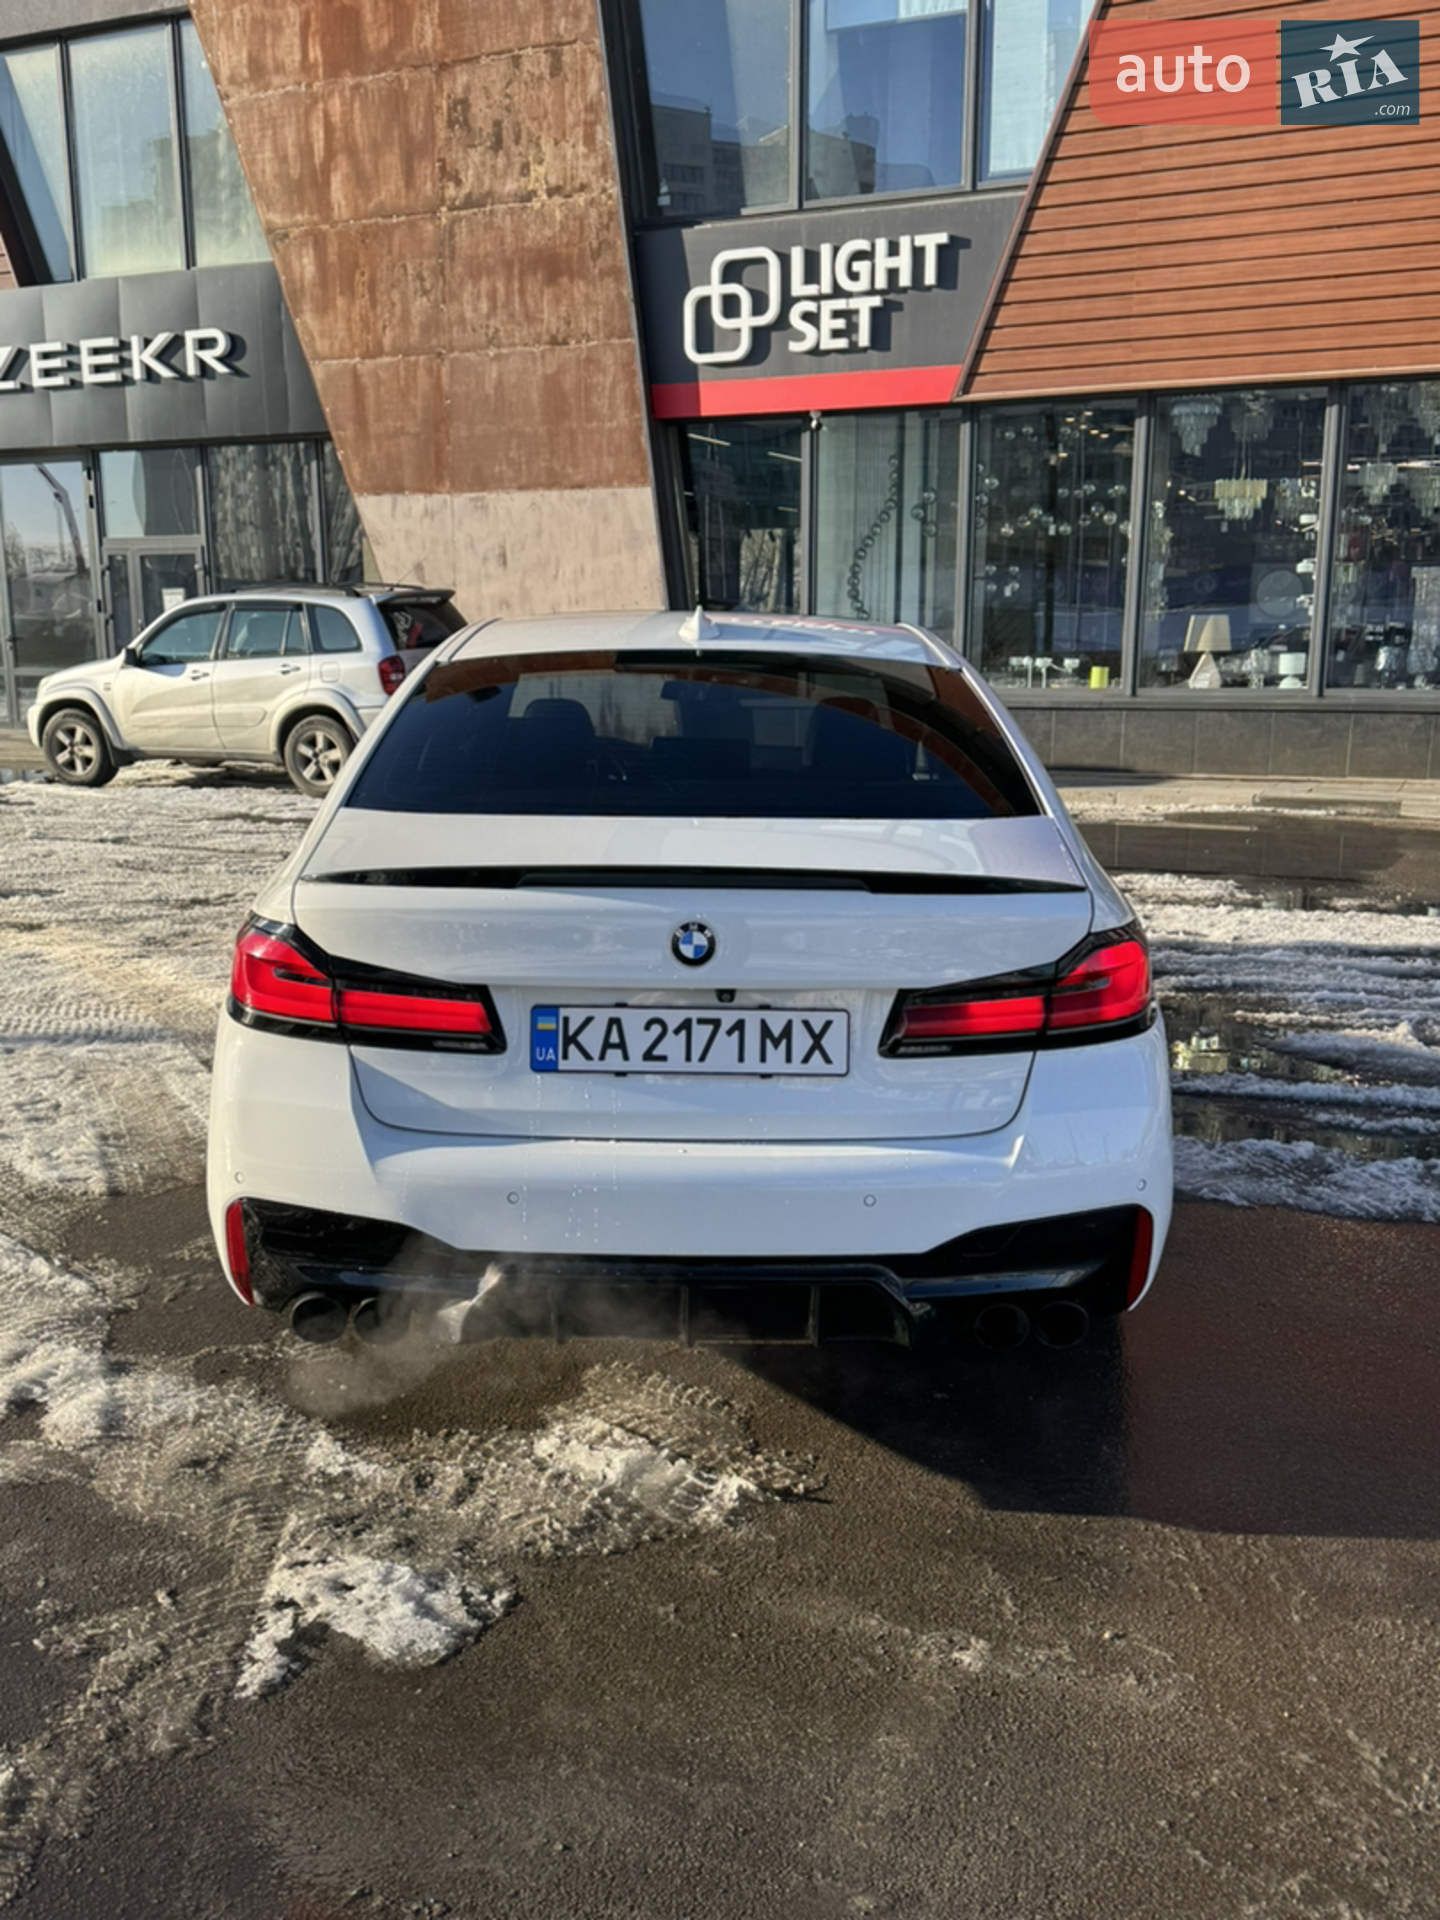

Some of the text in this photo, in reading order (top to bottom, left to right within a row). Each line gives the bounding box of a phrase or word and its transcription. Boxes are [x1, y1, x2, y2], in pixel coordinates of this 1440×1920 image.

[790, 232, 949, 297] LIGHT
[788, 295, 884, 353] SET
[536, 1047, 556, 1061] UA
[561, 1015, 834, 1065] KA 2171 MX
